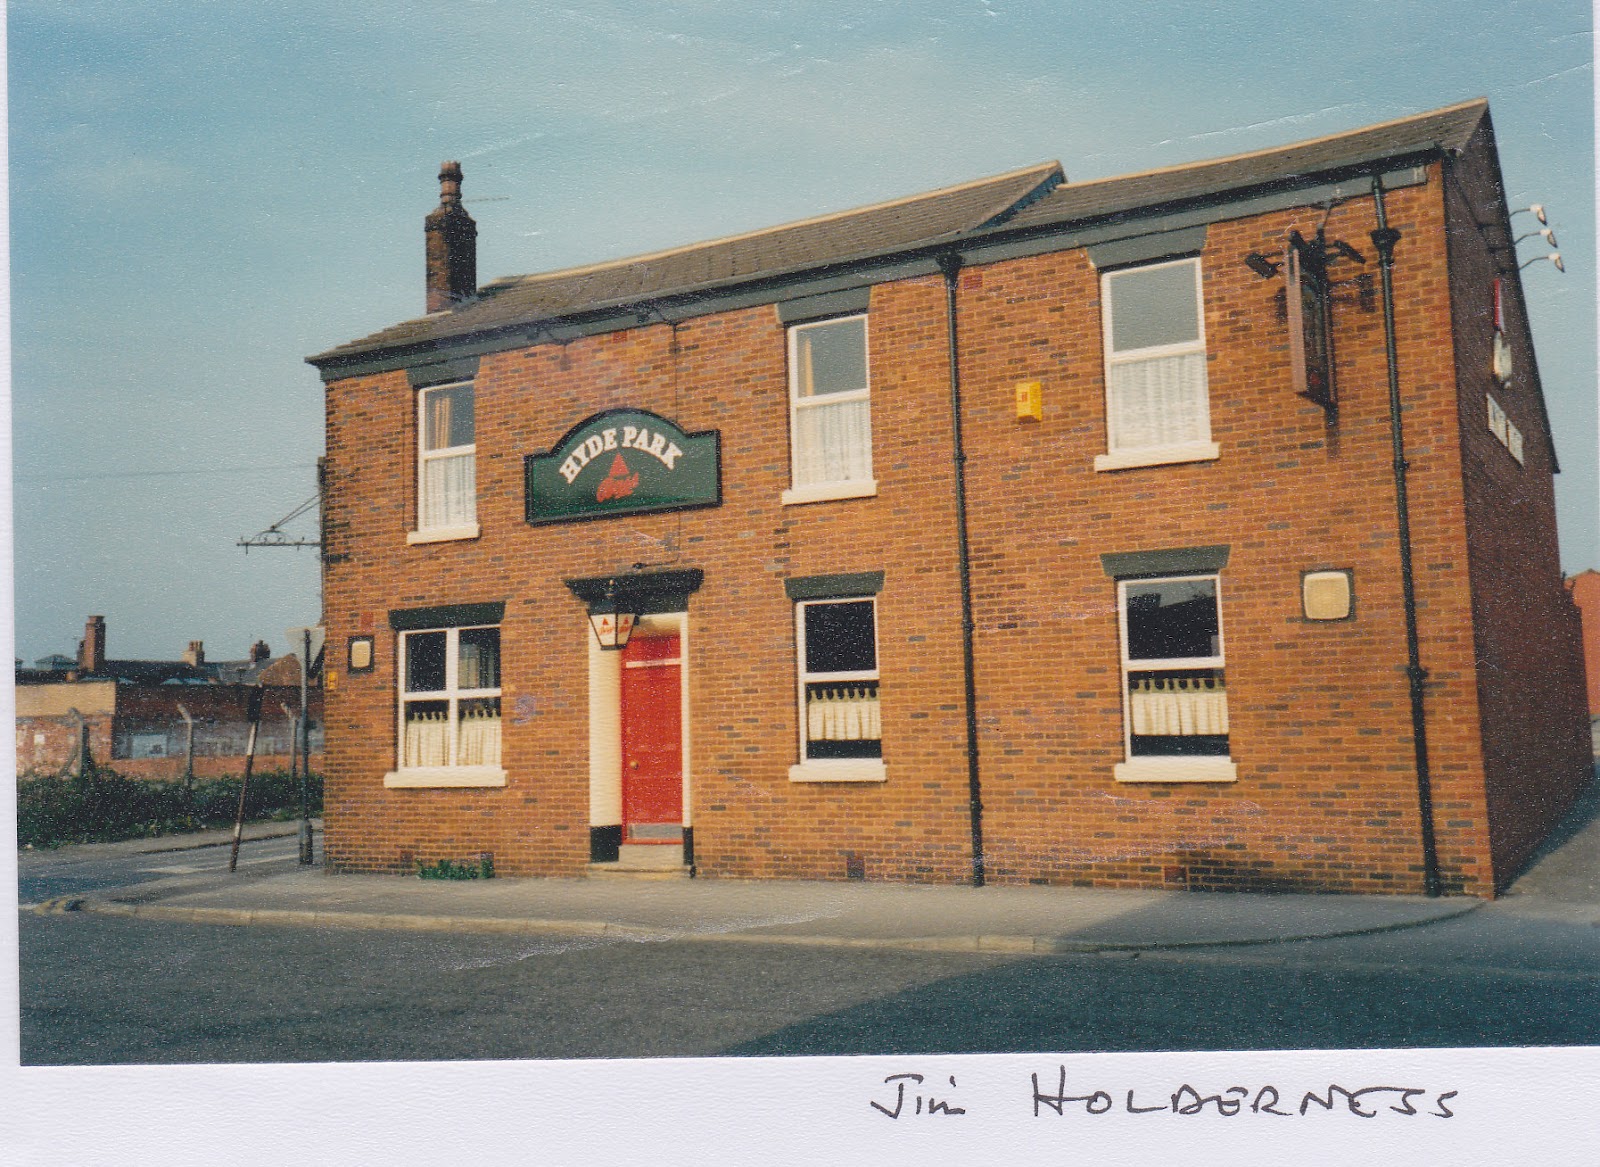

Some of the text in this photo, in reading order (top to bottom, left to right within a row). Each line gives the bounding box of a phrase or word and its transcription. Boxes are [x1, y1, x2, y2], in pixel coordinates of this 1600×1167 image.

[559, 426, 683, 484] HYDE PARK
[1031, 1065, 1458, 1118] HOLDERNESS
